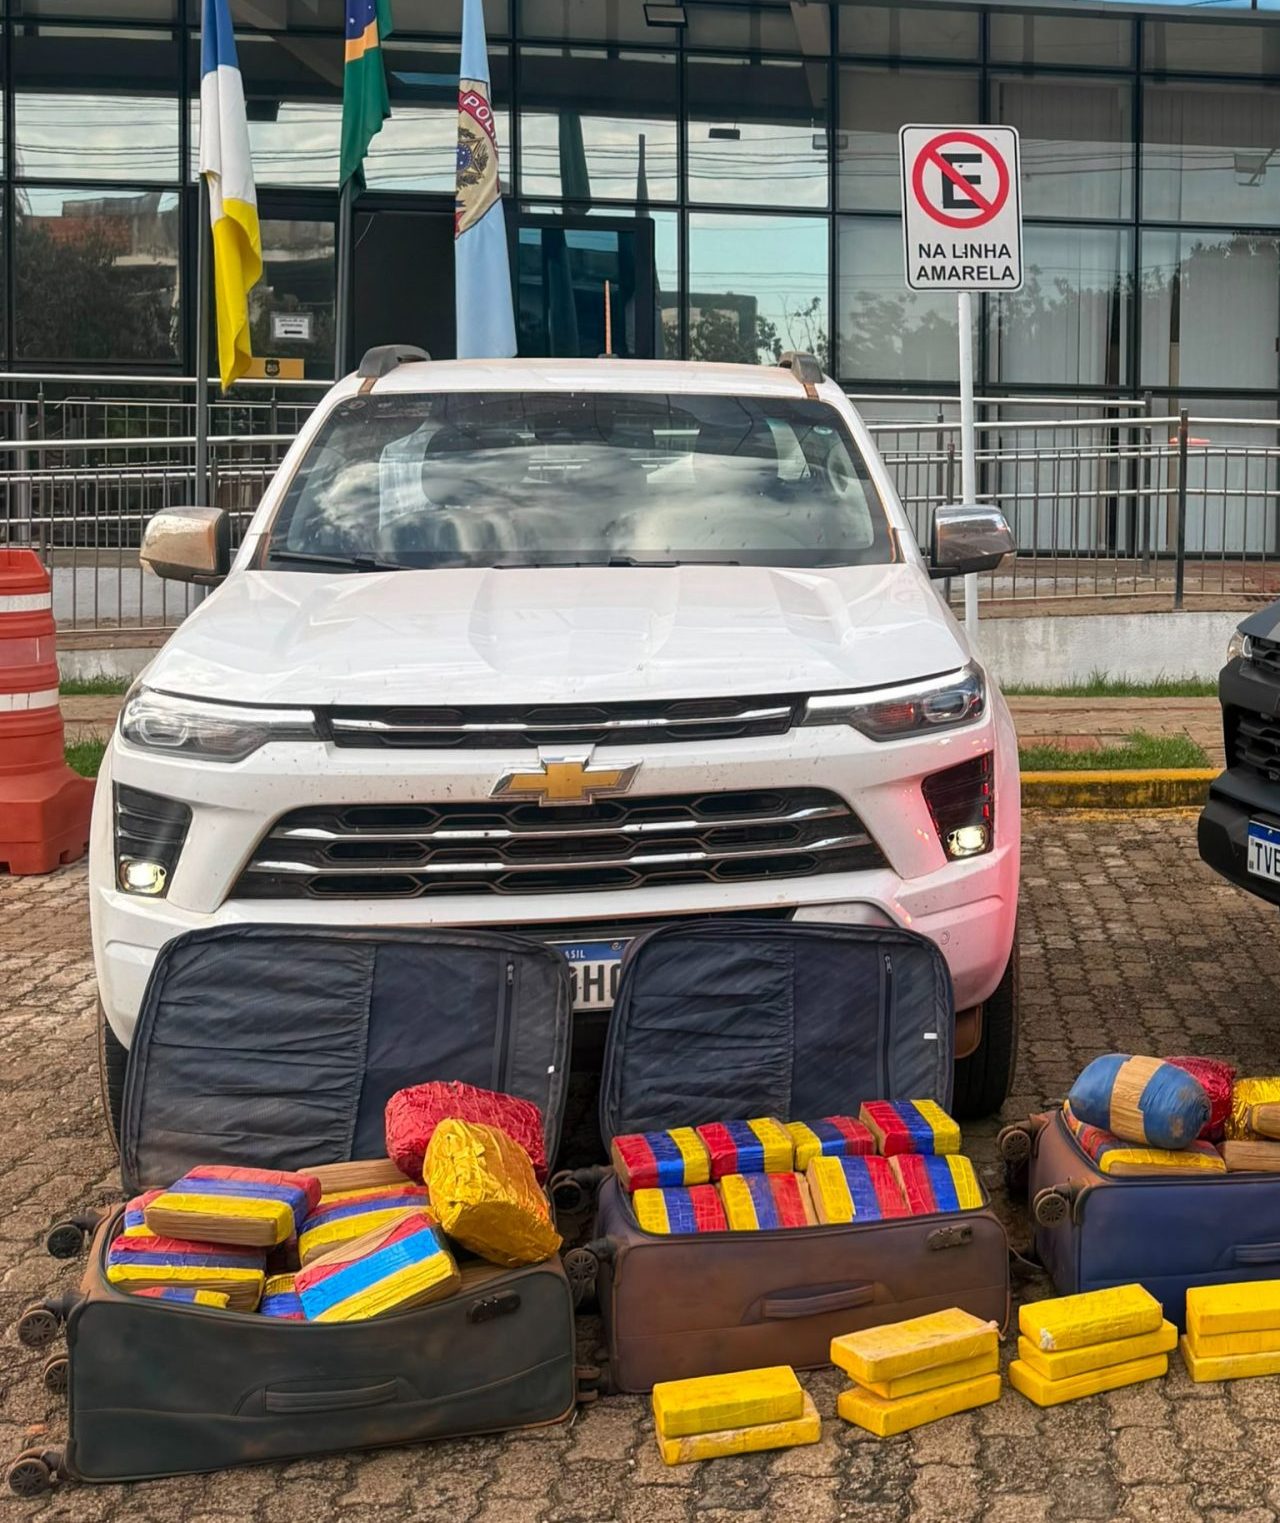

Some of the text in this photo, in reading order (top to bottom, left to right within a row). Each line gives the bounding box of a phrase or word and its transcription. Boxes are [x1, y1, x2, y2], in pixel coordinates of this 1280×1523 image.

[918, 243, 1012, 259] NA LINHA
[916, 265, 1015, 281] AMARELA
